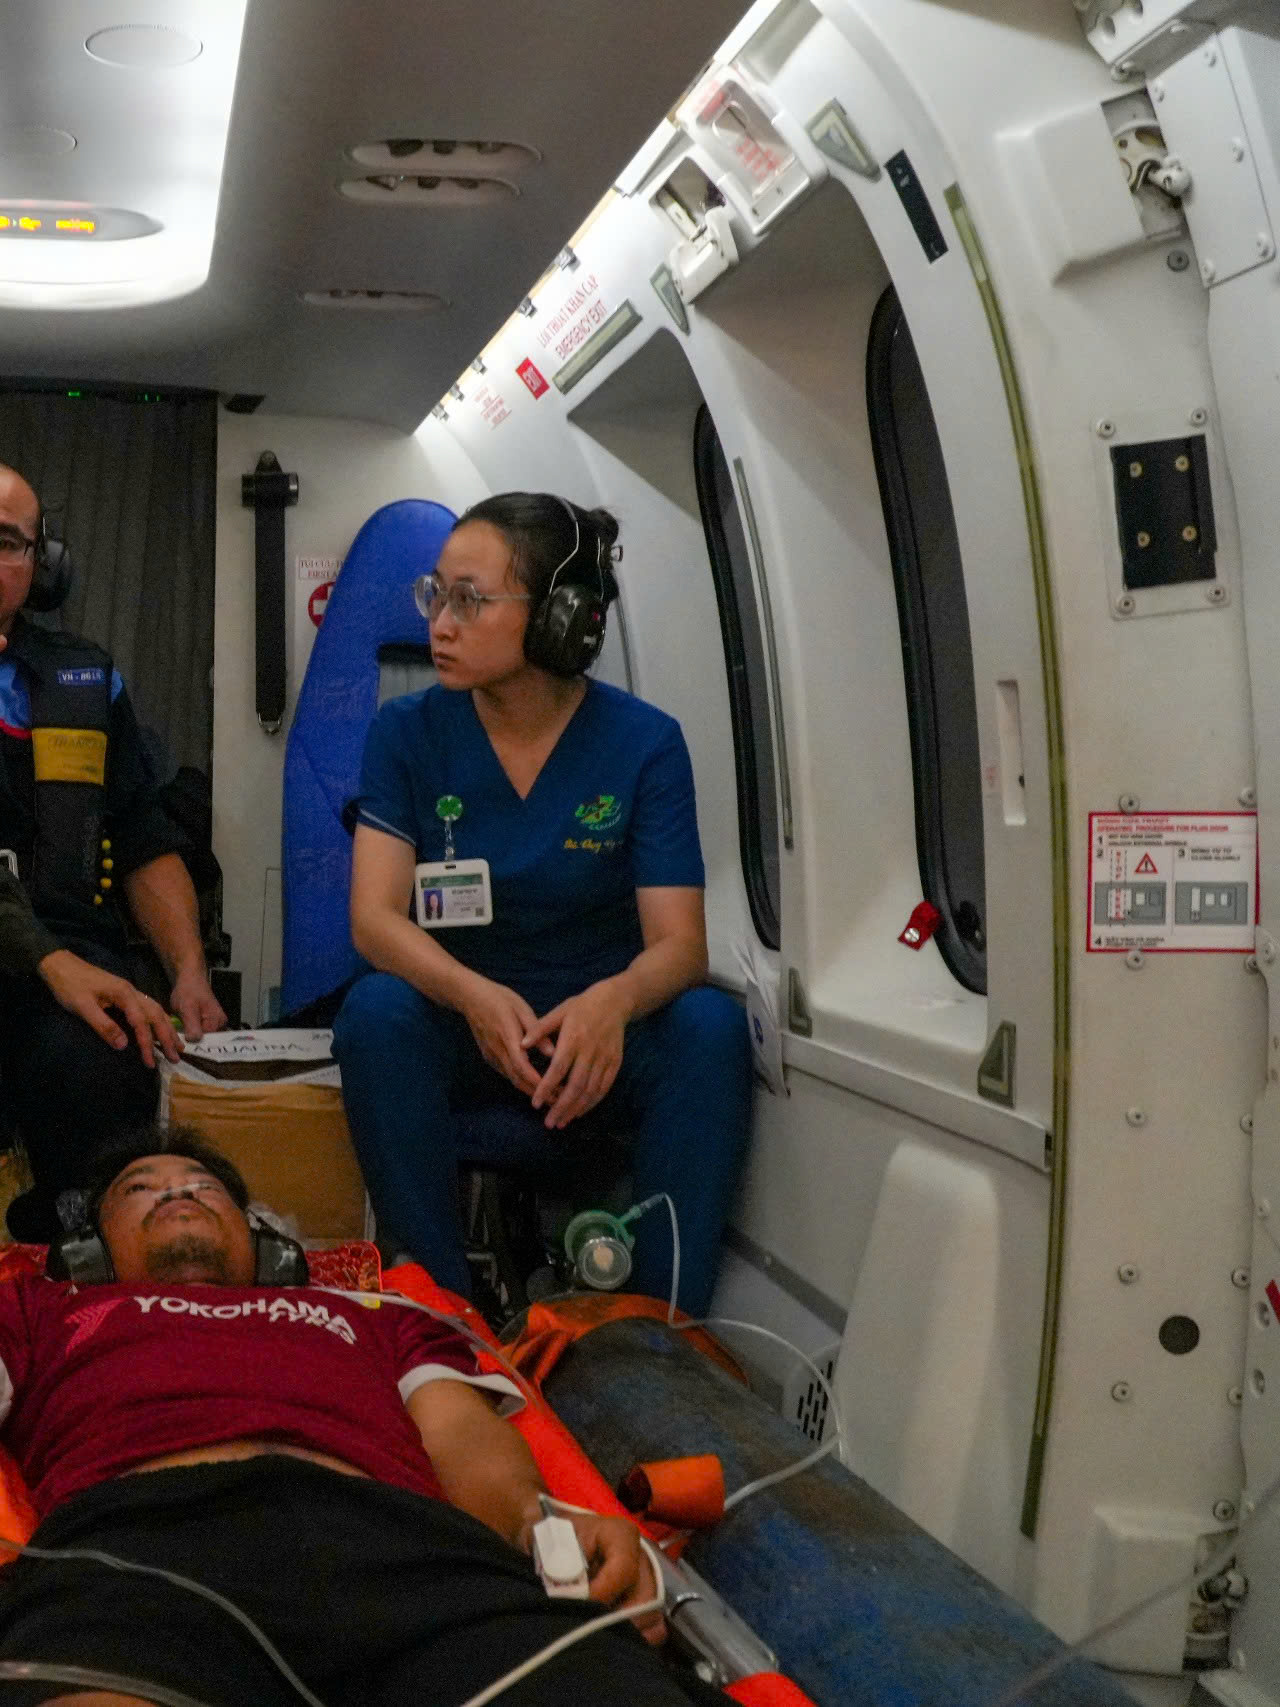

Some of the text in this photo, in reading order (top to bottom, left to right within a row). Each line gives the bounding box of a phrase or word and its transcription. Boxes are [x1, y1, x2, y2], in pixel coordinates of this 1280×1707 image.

[555, 298, 609, 360] EMERGENCY EXIT
[133, 1296, 358, 1344] YOKOHAMA
